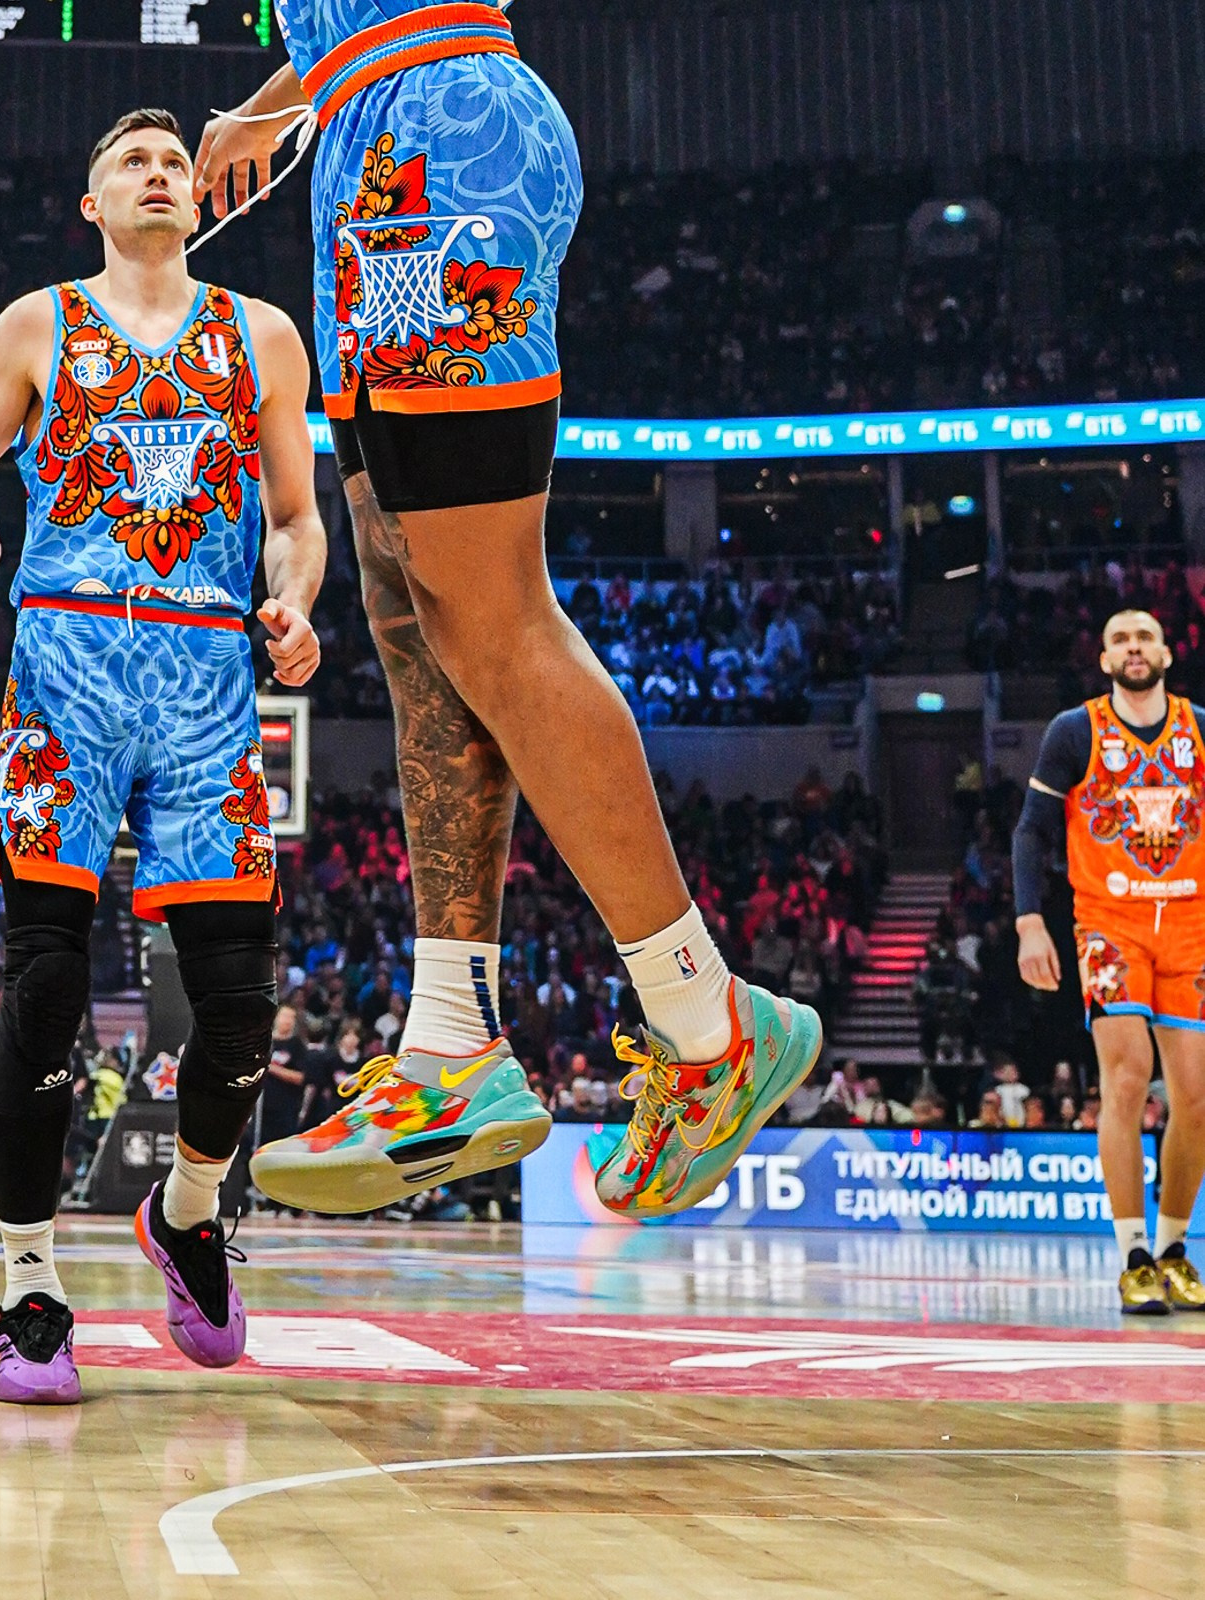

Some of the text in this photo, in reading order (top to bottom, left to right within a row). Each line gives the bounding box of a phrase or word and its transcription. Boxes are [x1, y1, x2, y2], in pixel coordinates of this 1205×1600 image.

[71, 340, 107, 352] ZEDO
[130, 425, 193, 444] GOSTI
[583, 411, 1201, 450] ВТБ ВТБ ВТБ ВТБ ВТБ ВТБ ВТБ ВТБ ВТБ
[1172, 737, 1195, 768] 12
[833, 1148, 1023, 1183] ТИТУЛЬНЫЙ
[835, 1186, 967, 1222] ЕДИНОЙ
[972, 1191, 1058, 1219] ЛИГИ
